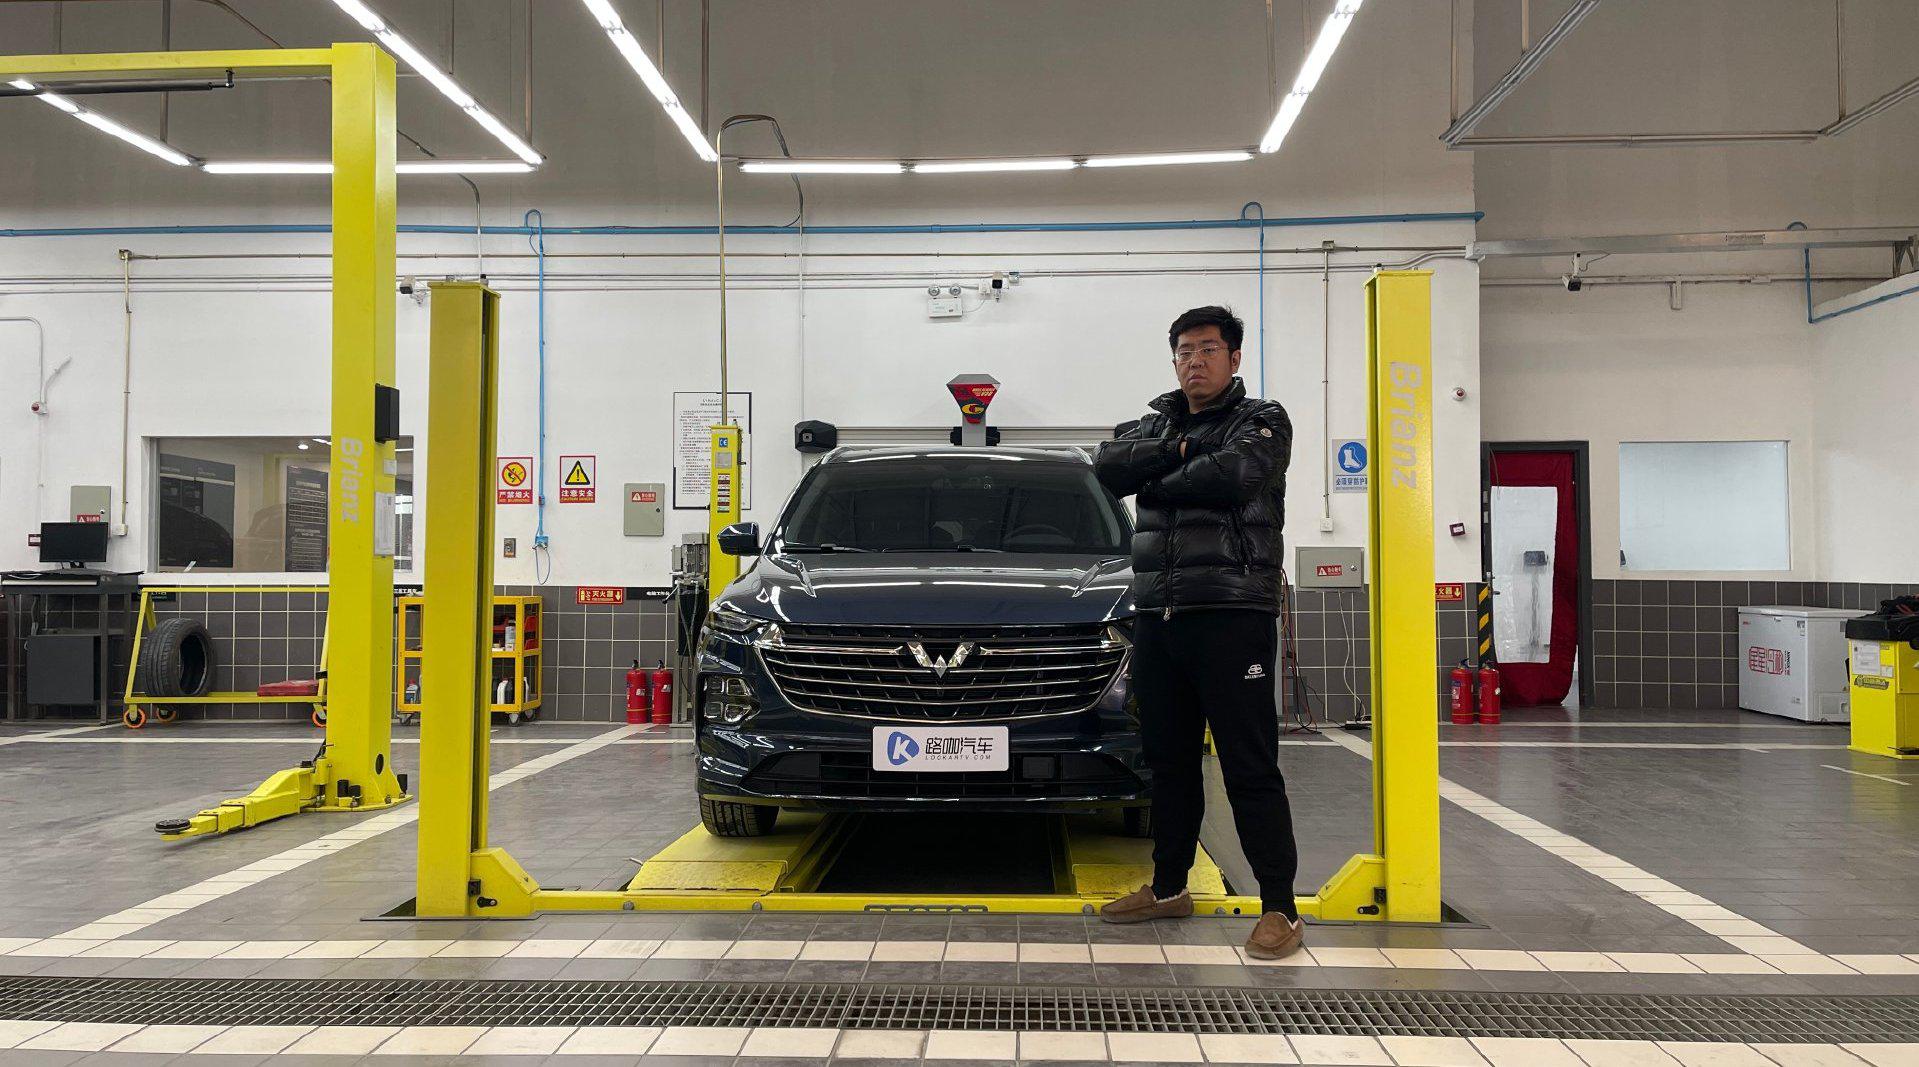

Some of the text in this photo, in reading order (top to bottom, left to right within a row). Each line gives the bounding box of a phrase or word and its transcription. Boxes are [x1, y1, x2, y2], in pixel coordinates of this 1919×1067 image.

[1390, 361, 1422, 489] Brianz
[341, 437, 363, 522] Brianz
[561, 489, 594, 498] 注意安全
[925, 737, 994, 755] 路咖汽车
